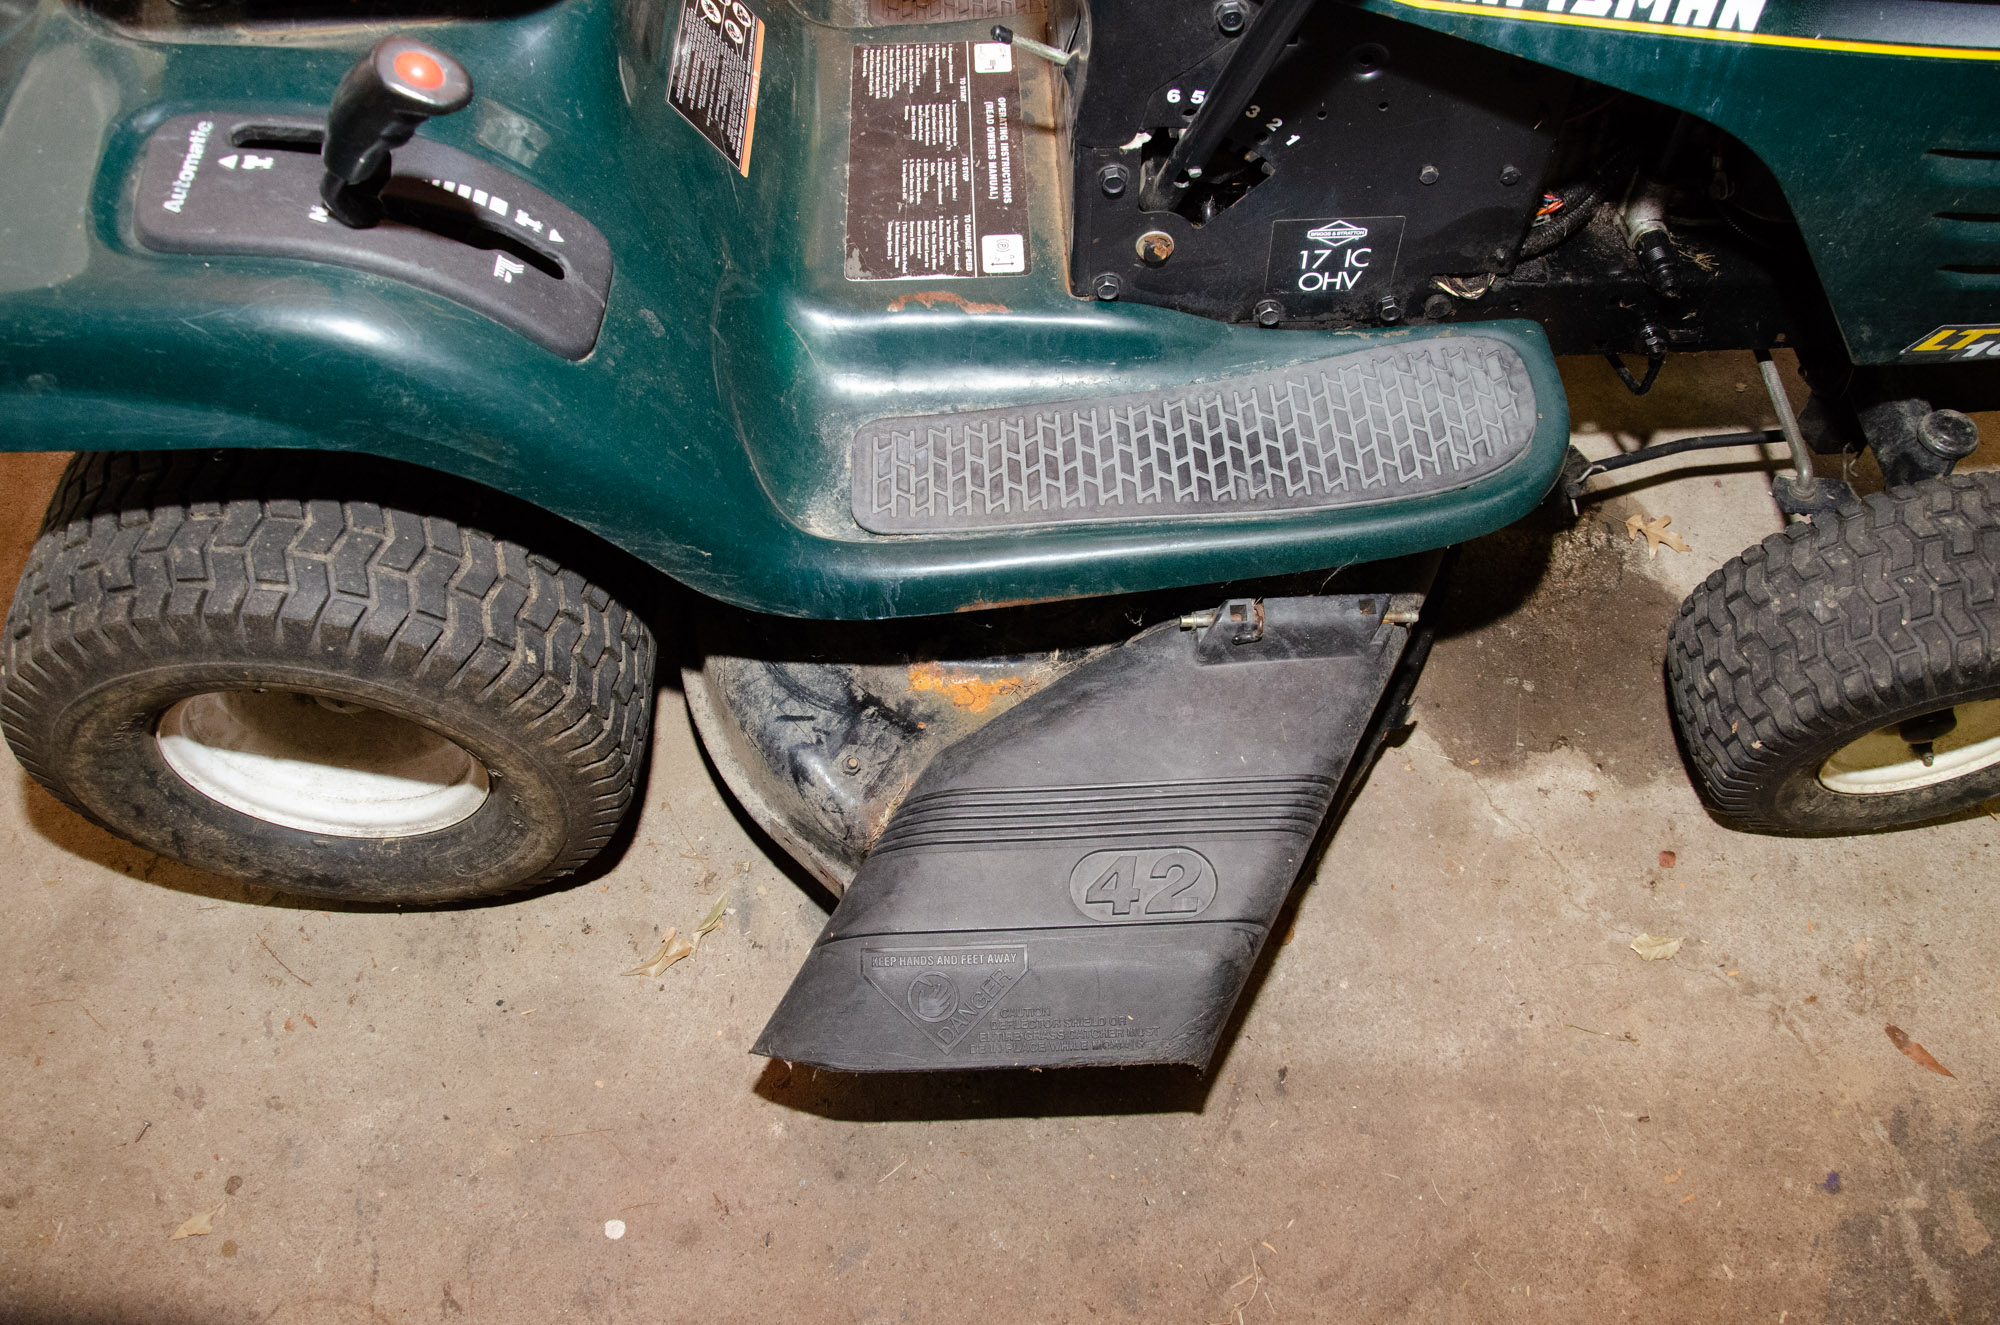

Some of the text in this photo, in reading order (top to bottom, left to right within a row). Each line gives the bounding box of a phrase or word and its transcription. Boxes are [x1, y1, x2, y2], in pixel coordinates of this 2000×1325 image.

[1166, 88, 1206, 104] 6 5
[1245, 105, 1261, 118] 3
[1266, 118, 1283, 132] 2
[1285, 134, 1301, 146] 1
[984, 101, 999, 200] (READ OWNERS MANUAL)
[997, 97, 1013, 204] OPERATING INSTRUCTIONS
[162, 120, 215, 214] Automatic
[964, 214, 971, 223] TO
[965, 250, 973, 272] SPEED
[1300, 248, 1372, 270] 17 IC
[1298, 270, 1363, 291] OHV
[1912, 328, 2000, 351] LT
[1085, 852, 1203, 915] 42
[871, 952, 1018, 967] KEEP HANDS AND FEET AWAY
[936, 968, 1013, 1046] DANGER
[1000, 1007, 1051, 1018] CAUTION
[991, 1015, 1128, 1031] DEFLECTOR SHIELD OR
[1024, 1030, 1066, 1042] GRASS
[1068, 1027, 1124, 1040] CATCHER
[1006, 1042, 1046, 1054] PLACE
[1048, 1040, 1089, 1053] WHILE
